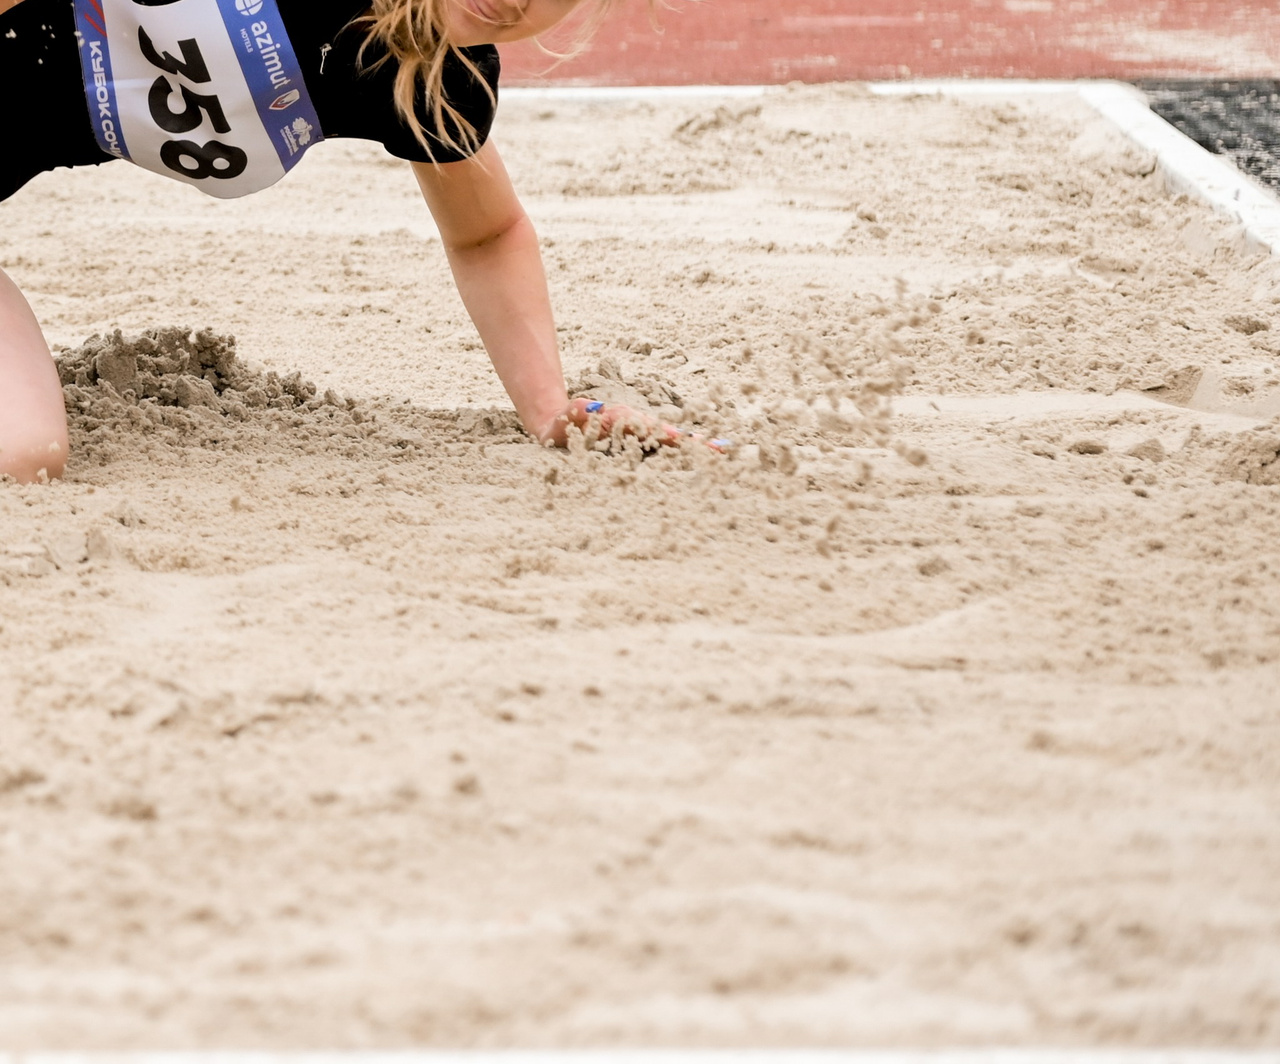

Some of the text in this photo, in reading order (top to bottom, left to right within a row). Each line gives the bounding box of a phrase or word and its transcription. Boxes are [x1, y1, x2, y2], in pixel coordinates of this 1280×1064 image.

[240, 28, 254, 54] HOTELS
[251, 20, 291, 90] azimut
[89, 40, 112, 118] КУБОК
[138, 25, 248, 179] 358
